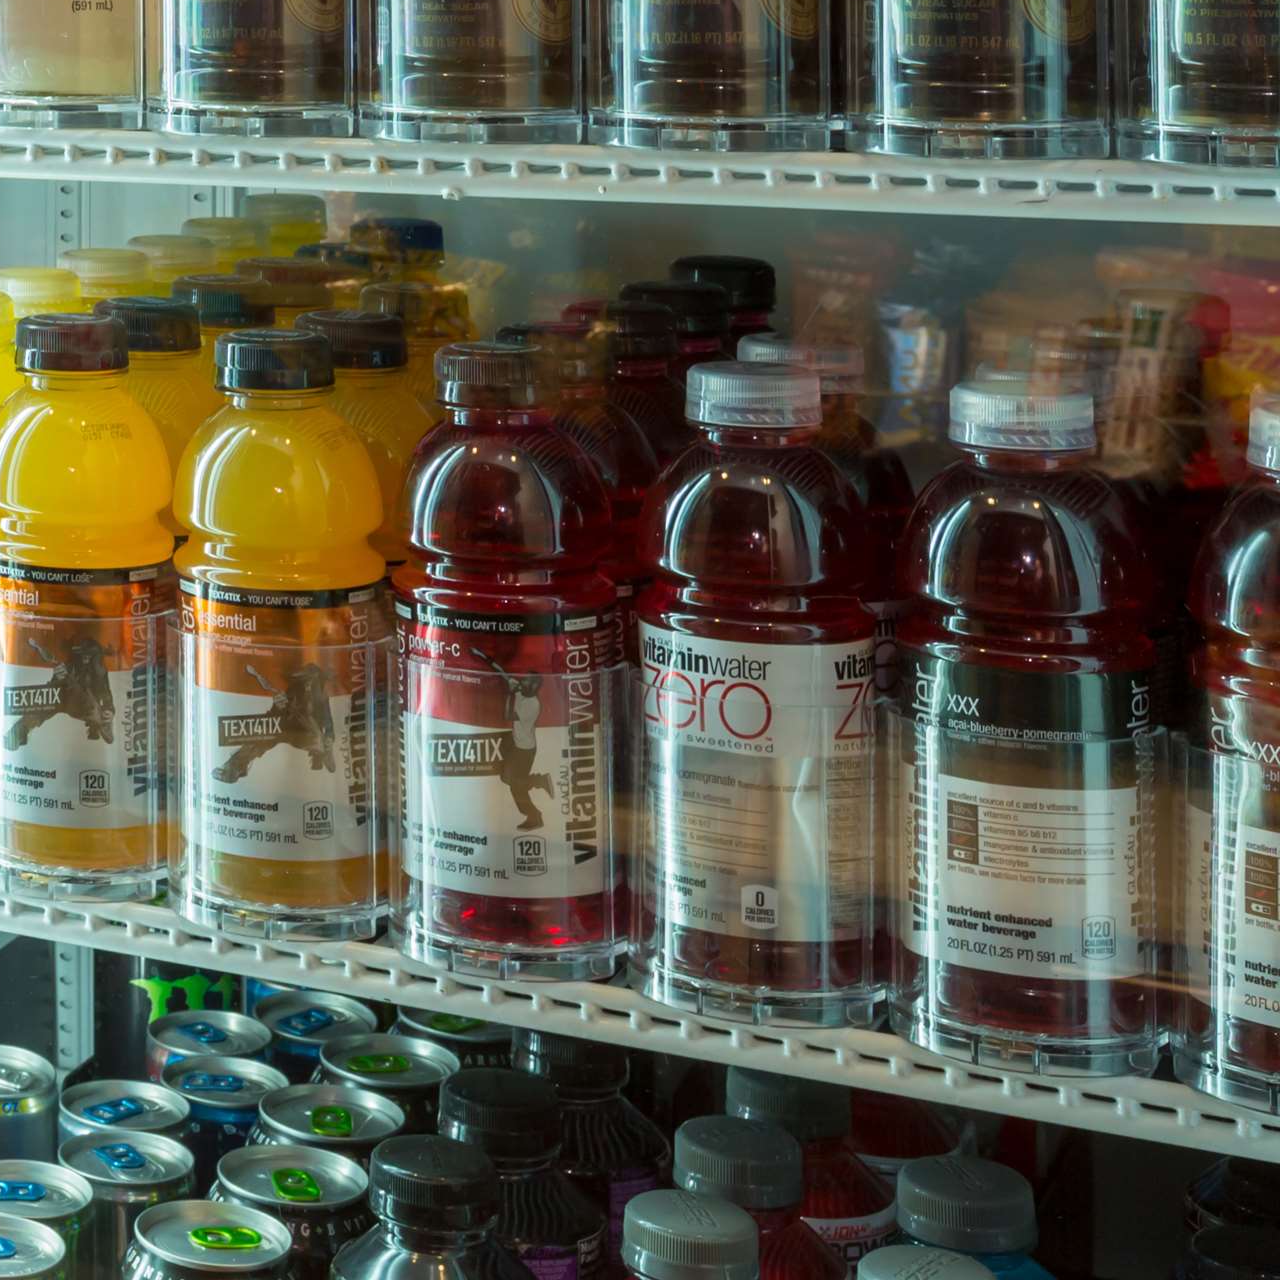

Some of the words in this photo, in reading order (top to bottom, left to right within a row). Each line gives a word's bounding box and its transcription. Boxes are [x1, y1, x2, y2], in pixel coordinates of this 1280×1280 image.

[71, 0, 93, 12] (591
[94, 0, 114, 12] mL)
[31, 570, 47, 582] YOU
[47, 572, 71, 583] CAN'T
[247, 595, 263, 606] YOU
[265, 596, 289, 606] CAN'T
[453, 619, 471, 631] YOU
[472, 620, 499, 632] CAN'T
[643, 635, 772, 681] vitaminwater
[5, 687, 62, 708] TEXT4TIX
[642, 662, 774, 741] zero
[946, 693, 980, 717] XXX
[221, 716, 283, 738] TEXT4TIX
[428, 736, 504, 765] TEXT4TIX
[686, 733, 774, 754] sweetened
[13, 765, 57, 779] enhanced
[83, 774, 105, 790] 120
[43, 798, 58, 809] 591
[60, 800, 75, 810] mL
[232, 799, 279, 812] enhanced
[1022, 801, 1038, 811] and
[223, 807, 266, 824] beverage
[307, 805, 329, 821] 120
[265, 831, 281, 843] 591
[283, 833, 300, 845] mL
[442, 830, 488, 847] enhanced
[518, 840, 541, 857] 120
[474, 865, 491, 878] 591
[493, 867, 510, 880] mL
[755, 890, 765, 909] 0
[946, 903, 991, 922] nutrient
[994, 913, 1053, 928] enhanced
[946, 916, 979, 931] water
[981, 921, 1037, 941] beverage
[1086, 920, 1111, 938] 120
[946, 937, 960, 950] 20
[960, 939, 973, 952] FL
[973, 941, 988, 955] OZ
[989, 944, 1014, 959] (1.25
[1016, 948, 1035, 962] PT)
[1036, 949, 1056, 964] 591
[1059, 951, 1077, 965] mL
[1244, 972, 1278, 989] water
[1244, 993, 1259, 1008] 20
[1258, 996, 1271, 1011] FL
